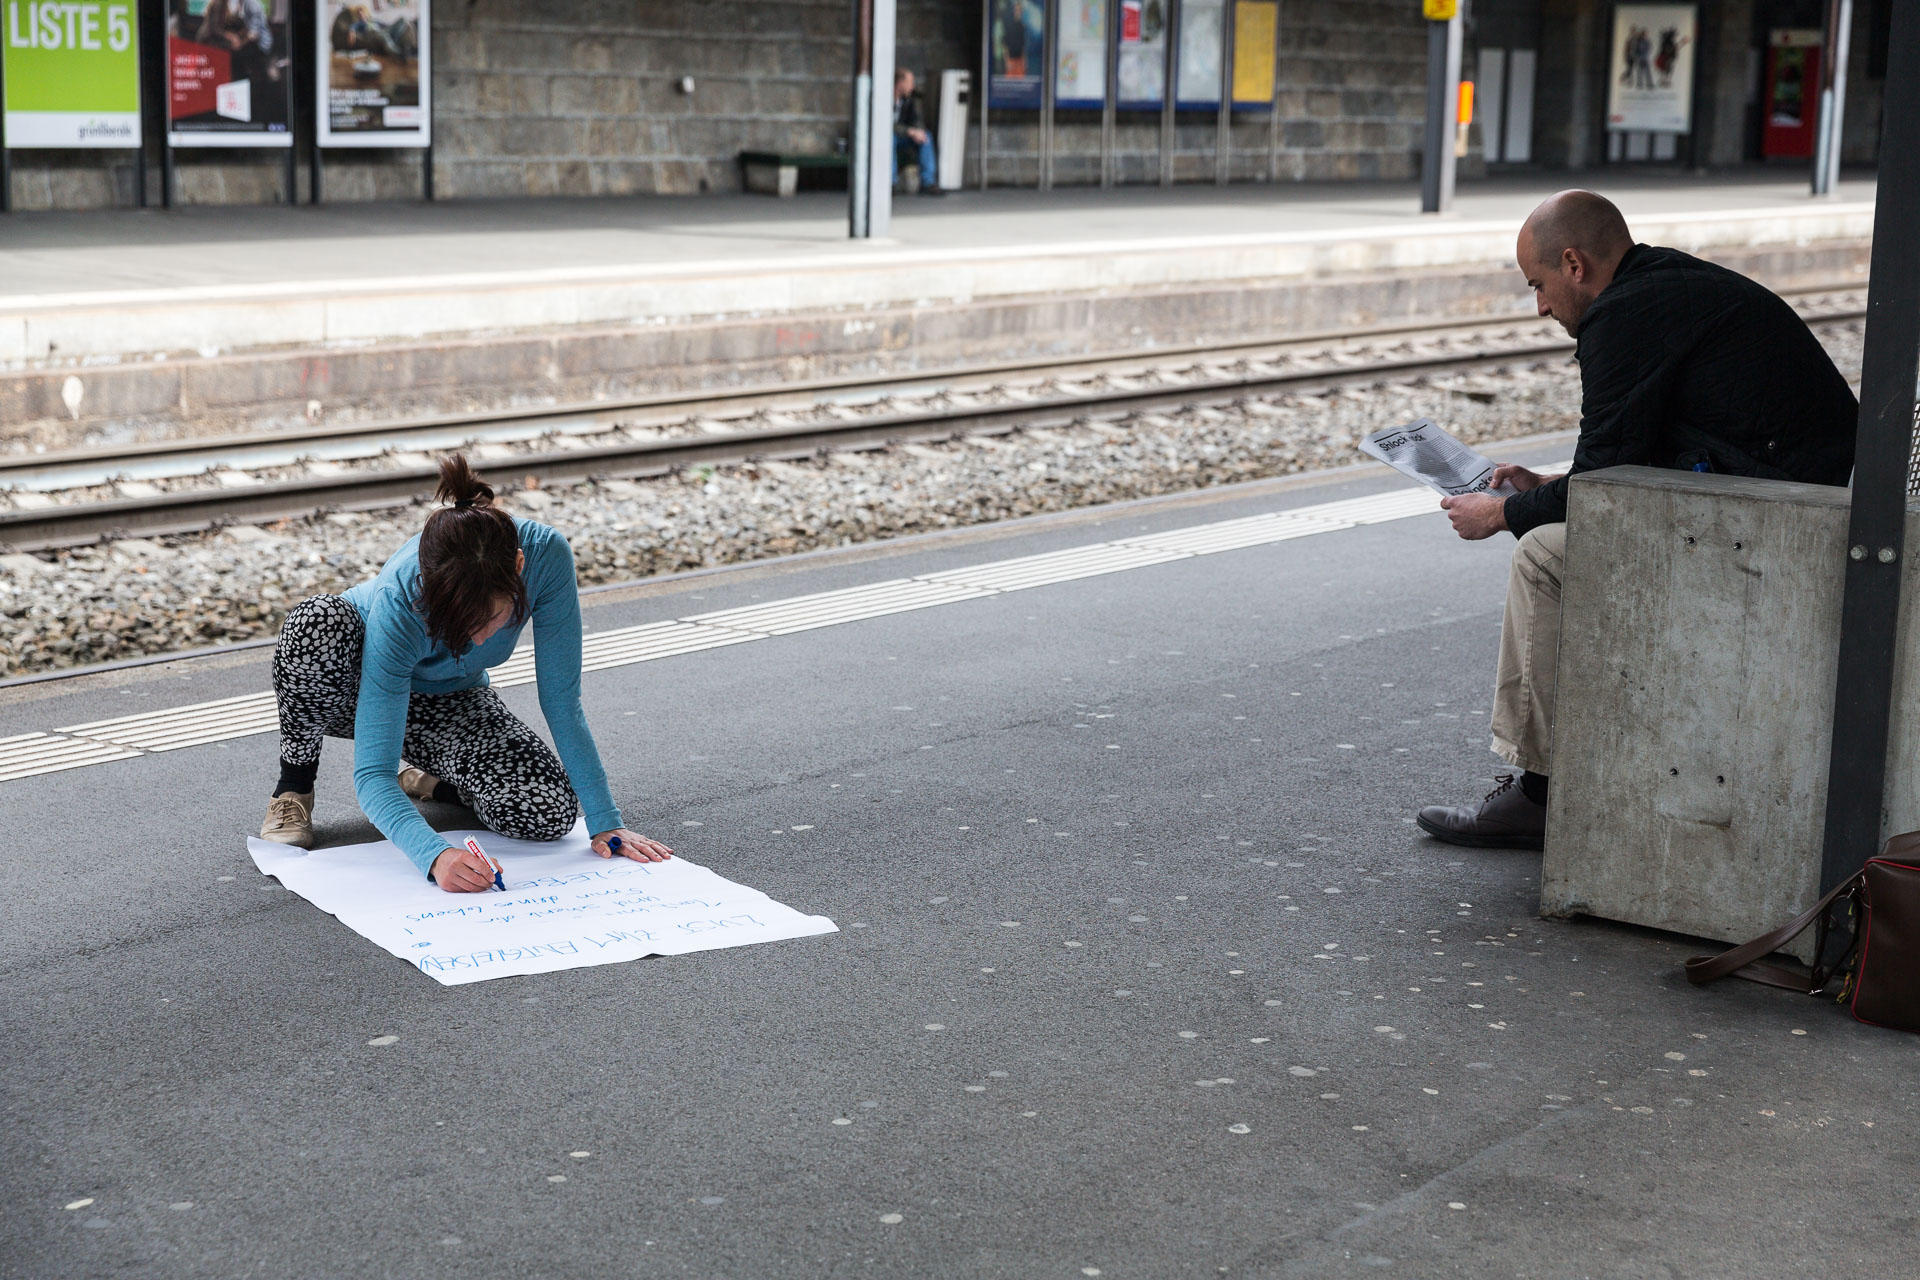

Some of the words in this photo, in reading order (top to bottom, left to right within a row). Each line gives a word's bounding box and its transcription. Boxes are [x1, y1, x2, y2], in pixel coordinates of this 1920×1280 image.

[9, 1, 102, 50] LISTE
[107, 4, 130, 52] 5
[678, 914, 766, 935] LUST
